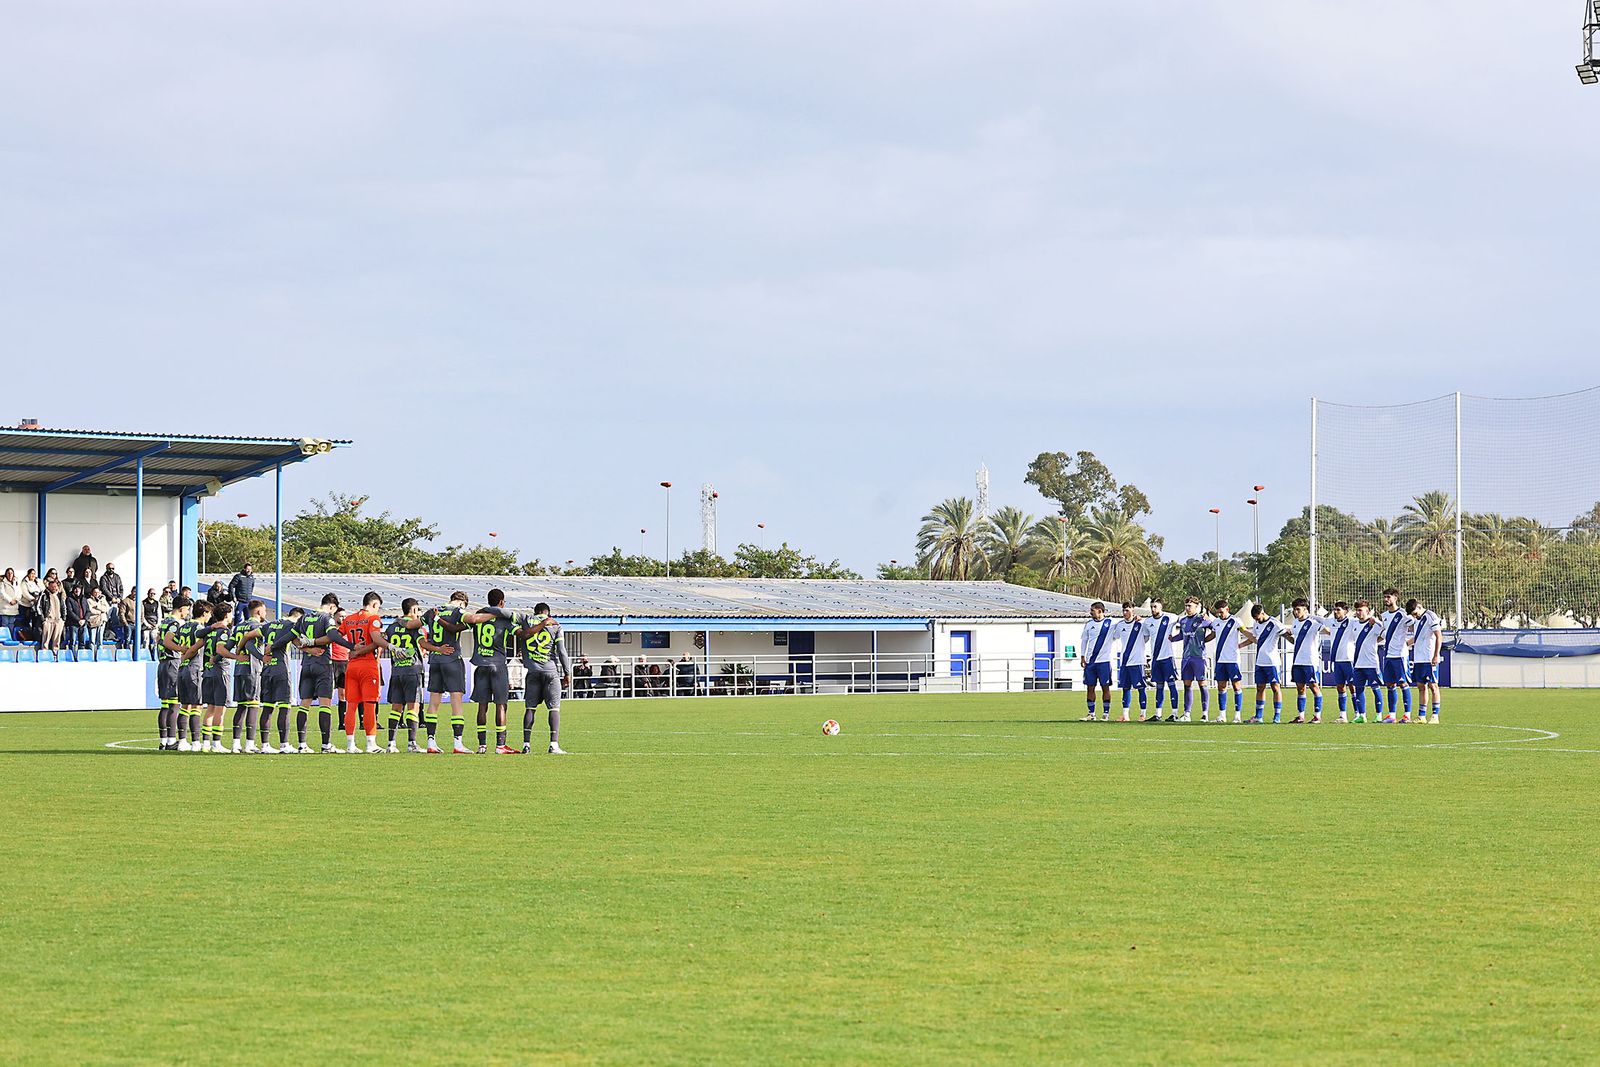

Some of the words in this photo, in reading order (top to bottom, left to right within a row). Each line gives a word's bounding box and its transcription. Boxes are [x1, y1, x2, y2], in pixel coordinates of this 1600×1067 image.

[305, 624, 315, 641] 4
[349, 627, 366, 646] 13
[432, 620, 444, 643] 9
[476, 622, 496, 648] 18
[526, 631, 552, 655] 22
